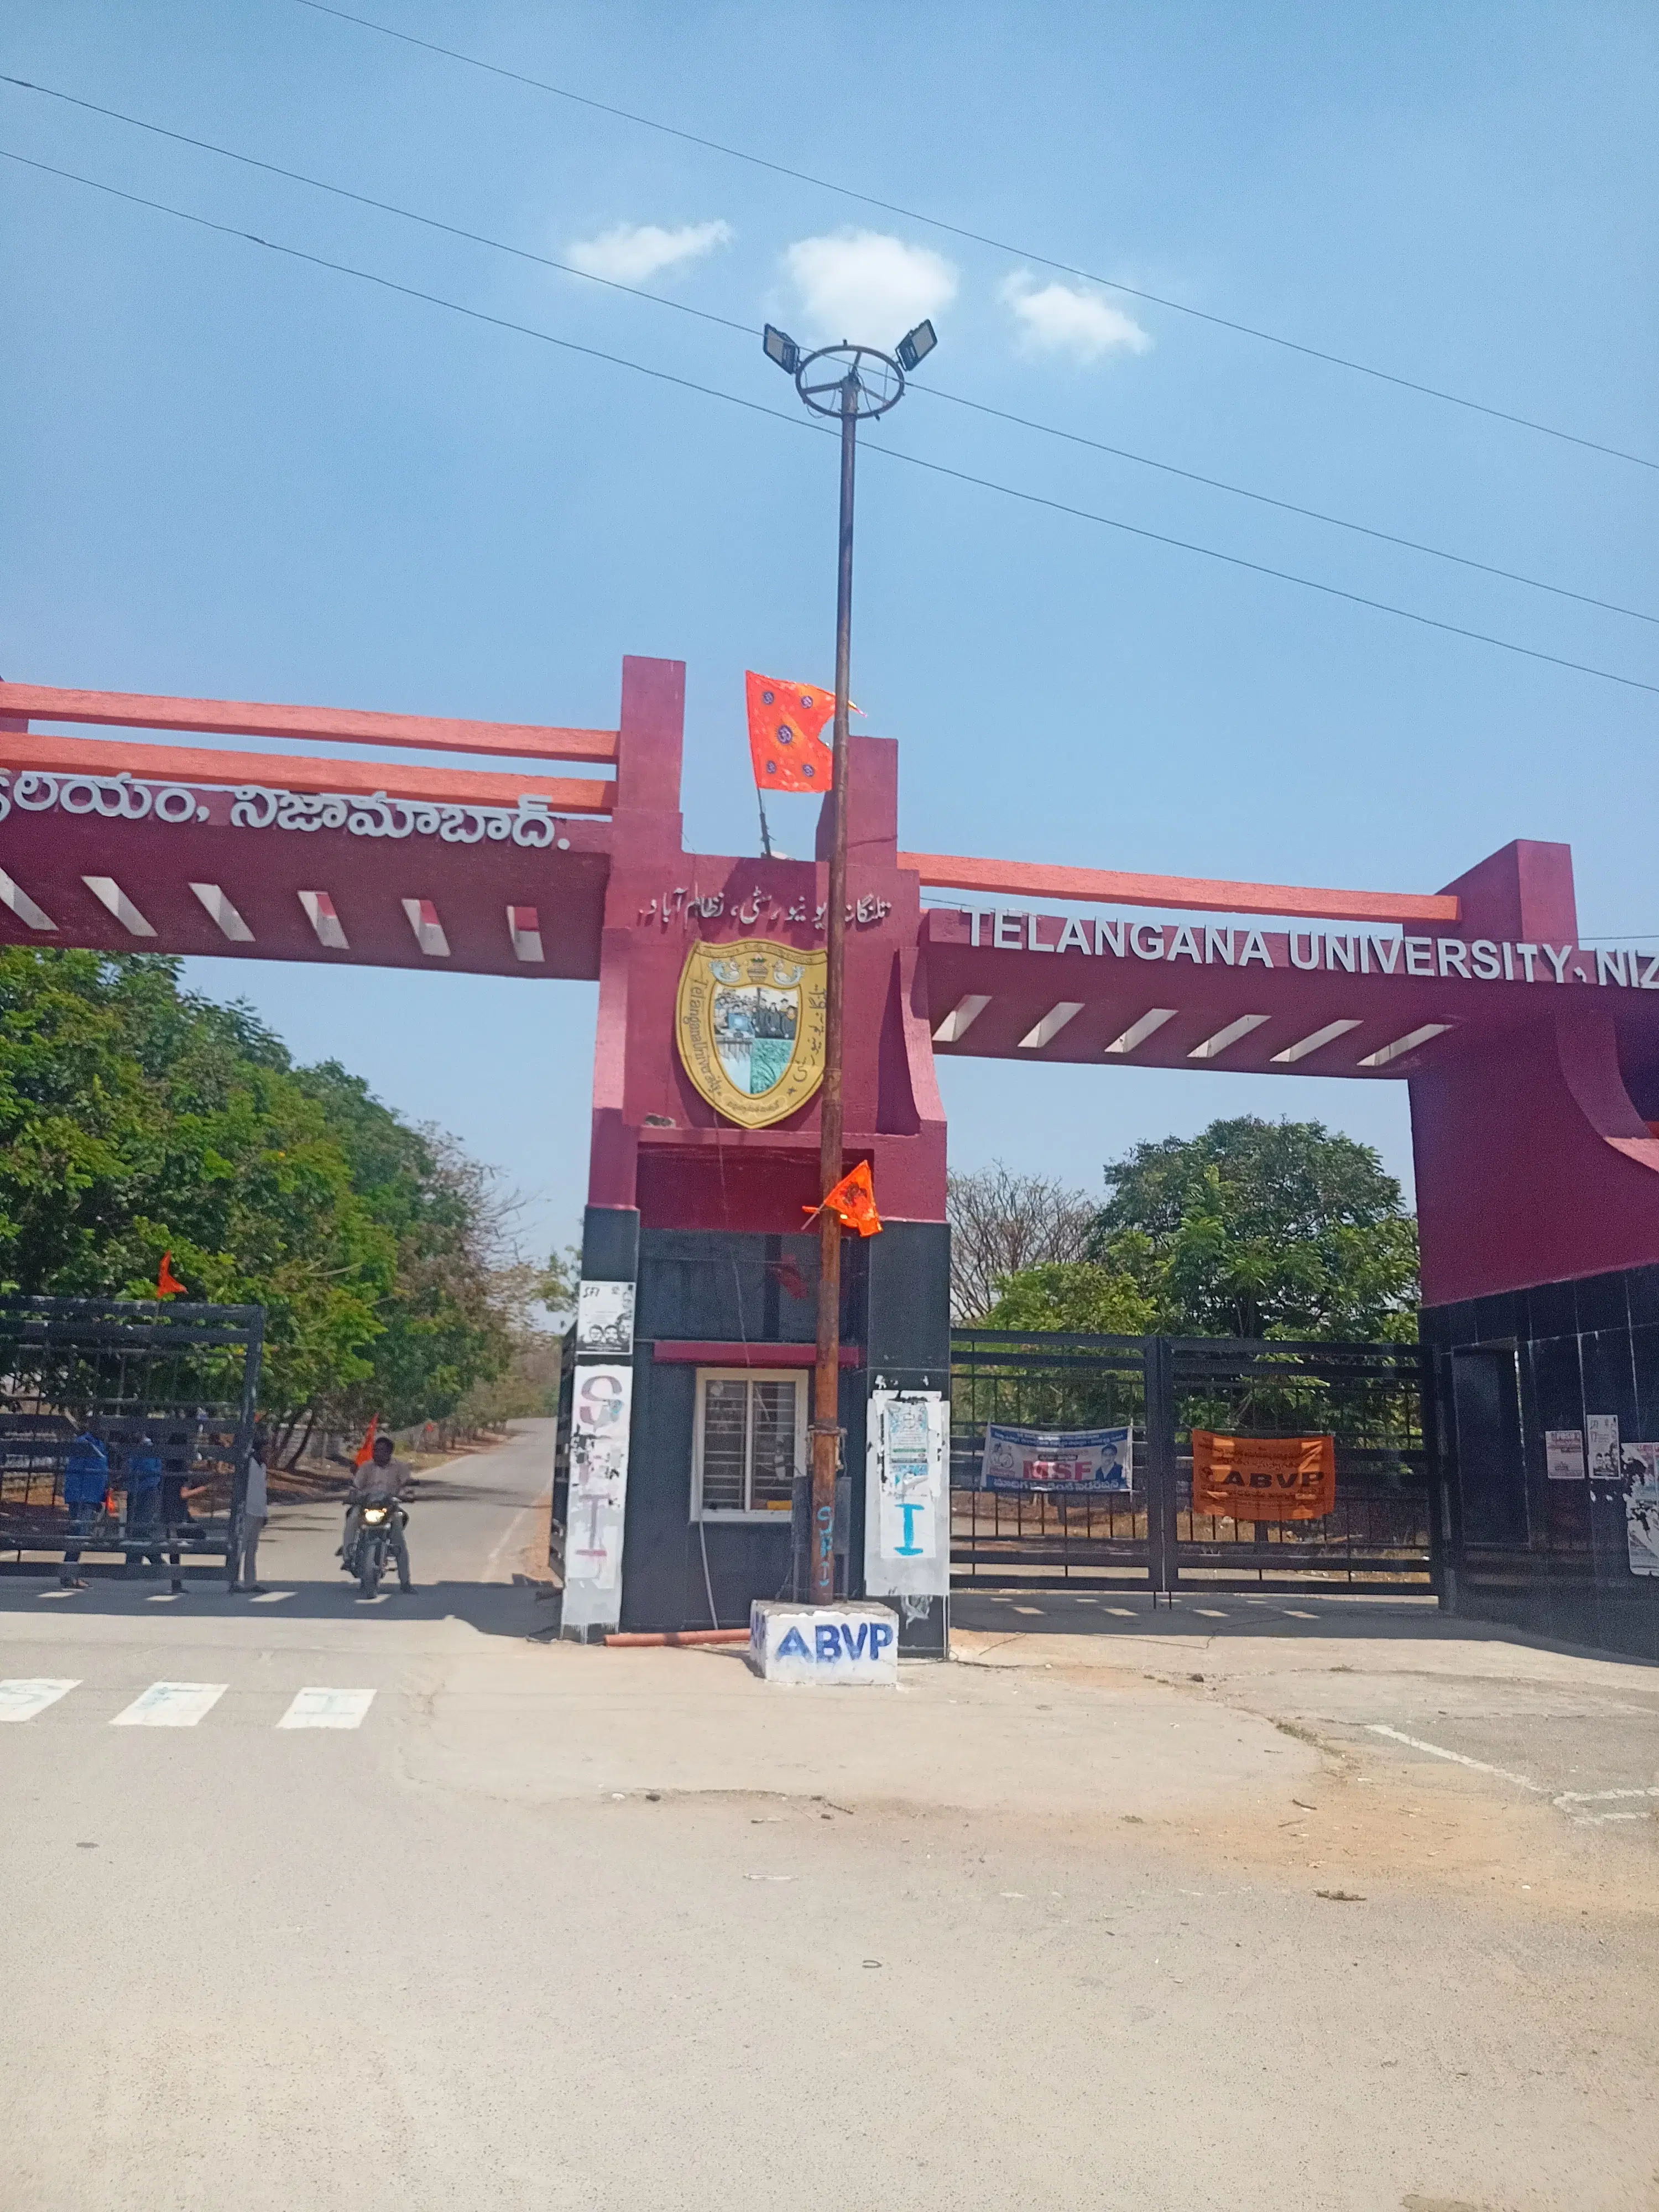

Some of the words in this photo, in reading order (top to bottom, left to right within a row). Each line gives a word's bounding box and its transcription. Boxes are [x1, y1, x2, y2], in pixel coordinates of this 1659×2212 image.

[231, 785, 570, 850] నిజామాబాద్.
[961, 905, 1274, 968] TELANGANA
[1289, 930, 1587, 984] UNIVERSITY,
[1023, 1459, 1093, 1481] MSF
[1223, 1470, 1324, 1489] ABVP
[775, 1621, 894, 1663] ABVP
